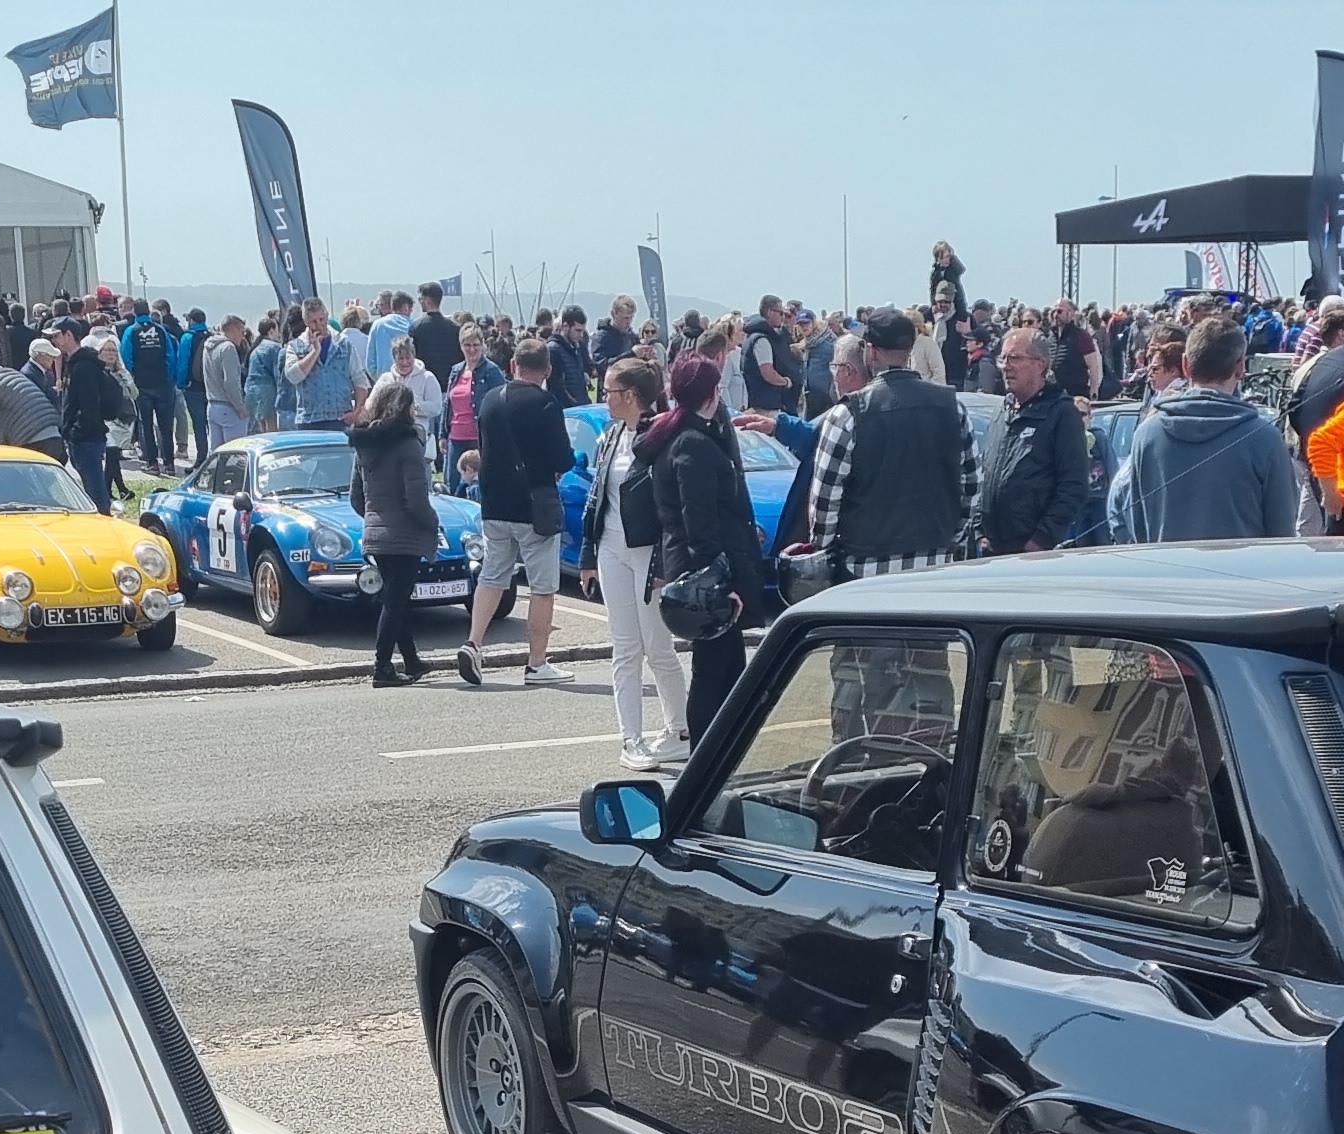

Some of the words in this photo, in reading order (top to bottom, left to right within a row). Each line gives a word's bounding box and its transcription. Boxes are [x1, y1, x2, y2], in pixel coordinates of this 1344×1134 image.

[216, 509, 227, 557] 5
[290, 549, 310, 562] elf
[47, 606, 119, 624] EX-115-MG
